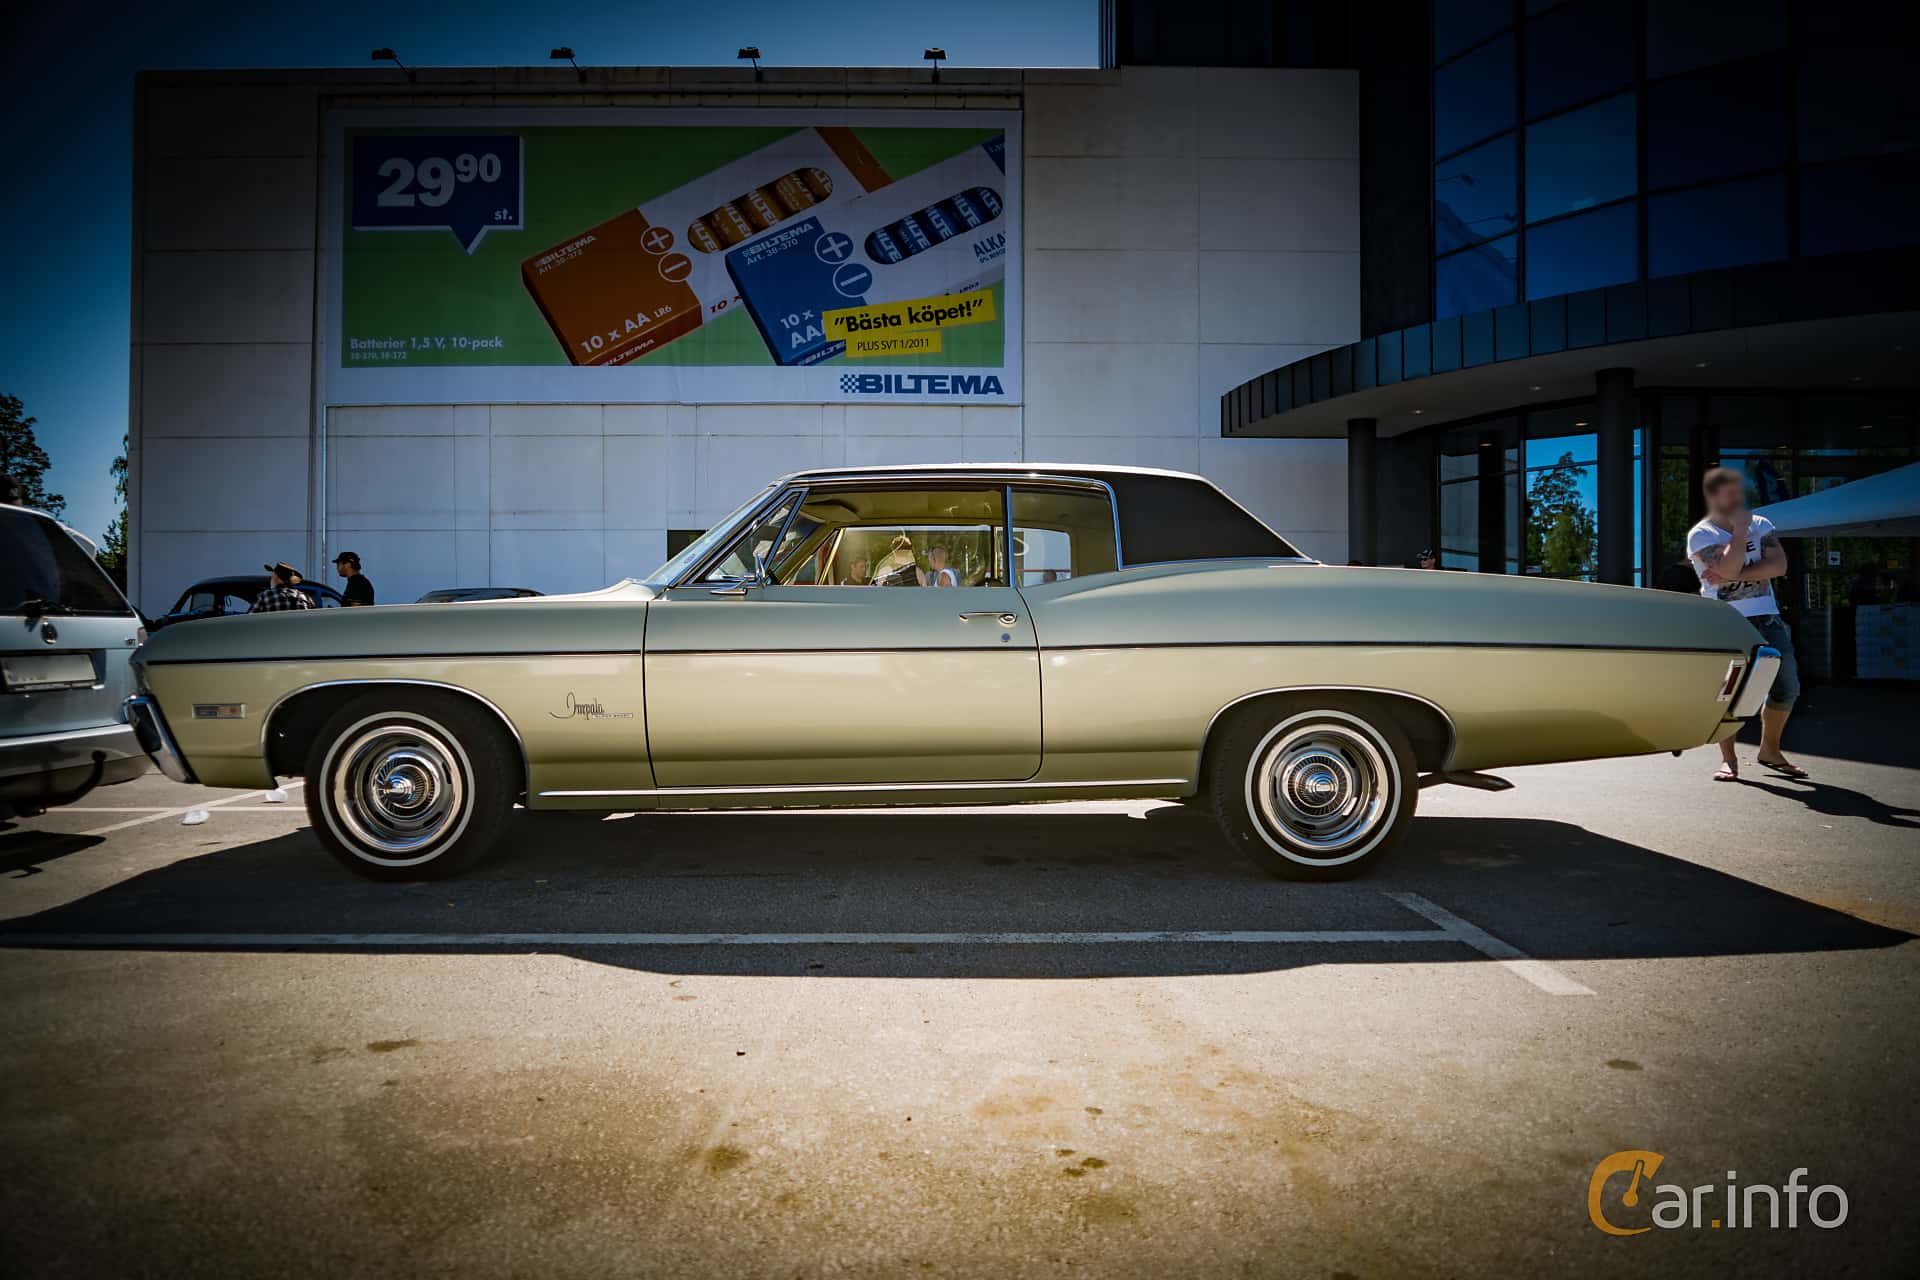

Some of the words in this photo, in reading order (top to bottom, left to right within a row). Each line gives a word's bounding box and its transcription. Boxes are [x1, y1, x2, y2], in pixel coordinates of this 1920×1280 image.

[494, 208, 513, 221] st.
[749, 223, 814, 255] BILTEMA
[973, 231, 1006, 258] ALKA
[747, 252, 765, 265] Art.
[780, 314, 800, 329] 10
[580, 335, 604, 353] 10
[624, 312, 651, 333] AA
[350, 337, 406, 349] Batterier
[410, 337, 431, 350] 1,5
[451, 336, 504, 351] 10-pack
[857, 340, 879, 352] PLUS
[881, 339, 898, 350] SVT
[899, 338, 929, 350] 1/2011
[858, 373, 1005, 395] BILTEMA
[549, 691, 606, 721] Impala
